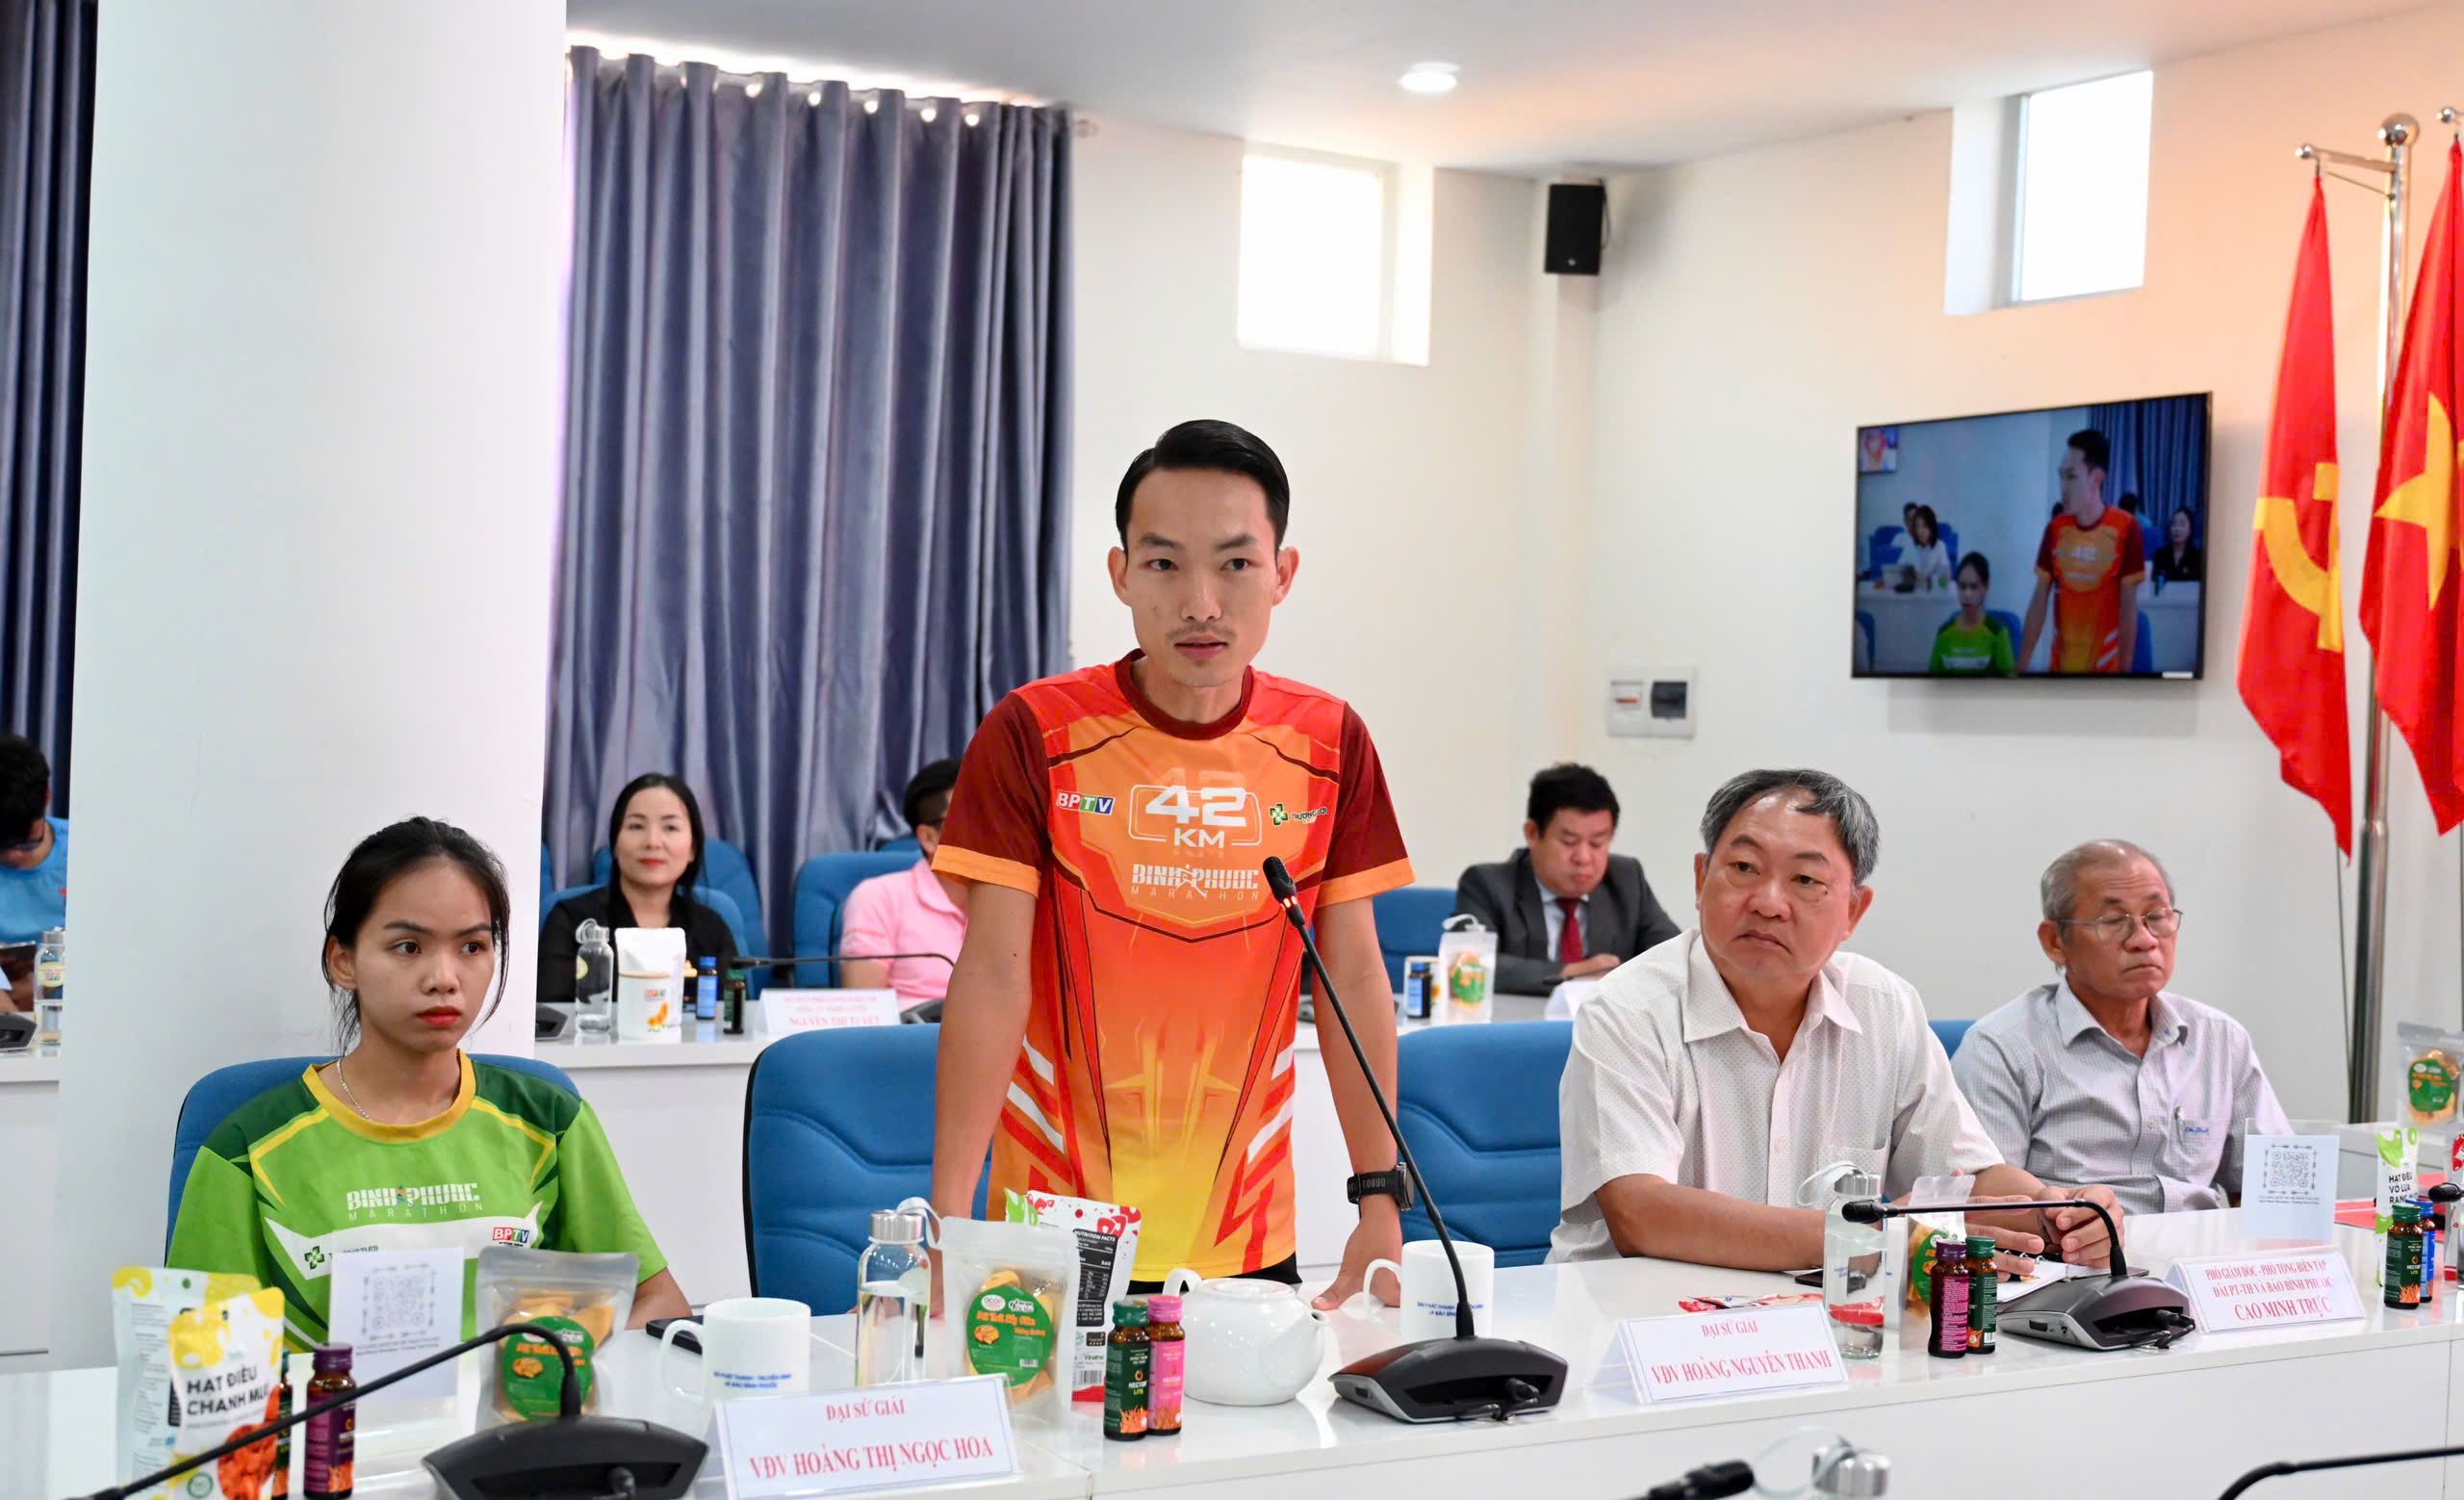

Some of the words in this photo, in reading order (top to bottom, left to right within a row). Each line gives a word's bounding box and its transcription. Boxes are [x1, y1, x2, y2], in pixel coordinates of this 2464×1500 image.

[1057, 791, 1114, 815] BPTV
[1145, 785, 1246, 827] 42
[1174, 827, 1225, 848] KM
[1131, 888, 1259, 901] MARATHON
[348, 1202, 483, 1222] MARATHON
[493, 1227, 530, 1243] BPTV
[2234, 1301, 2263, 1321] CAO
[2263, 1299, 2297, 1318] MINH
[2297, 1294, 2333, 1317] TRỰC
[1701, 1324, 1721, 1339] ĐẠI
[1651, 1362, 1680, 1384] VĐV
[1681, 1356, 1732, 1382] HOÀNG
[1784, 1350, 1833, 1371] THANH
[187, 1392, 246, 1416] CHANH
[826, 1403, 851, 1423] ĐẠI
[750, 1454, 787, 1479] VĐV
[793, 1443, 861, 1477] HOÀNG
[861, 1444, 898, 1472] THỊ
[899, 1439, 951, 1467] NGỌC
[954, 1435, 993, 1459] HOA
